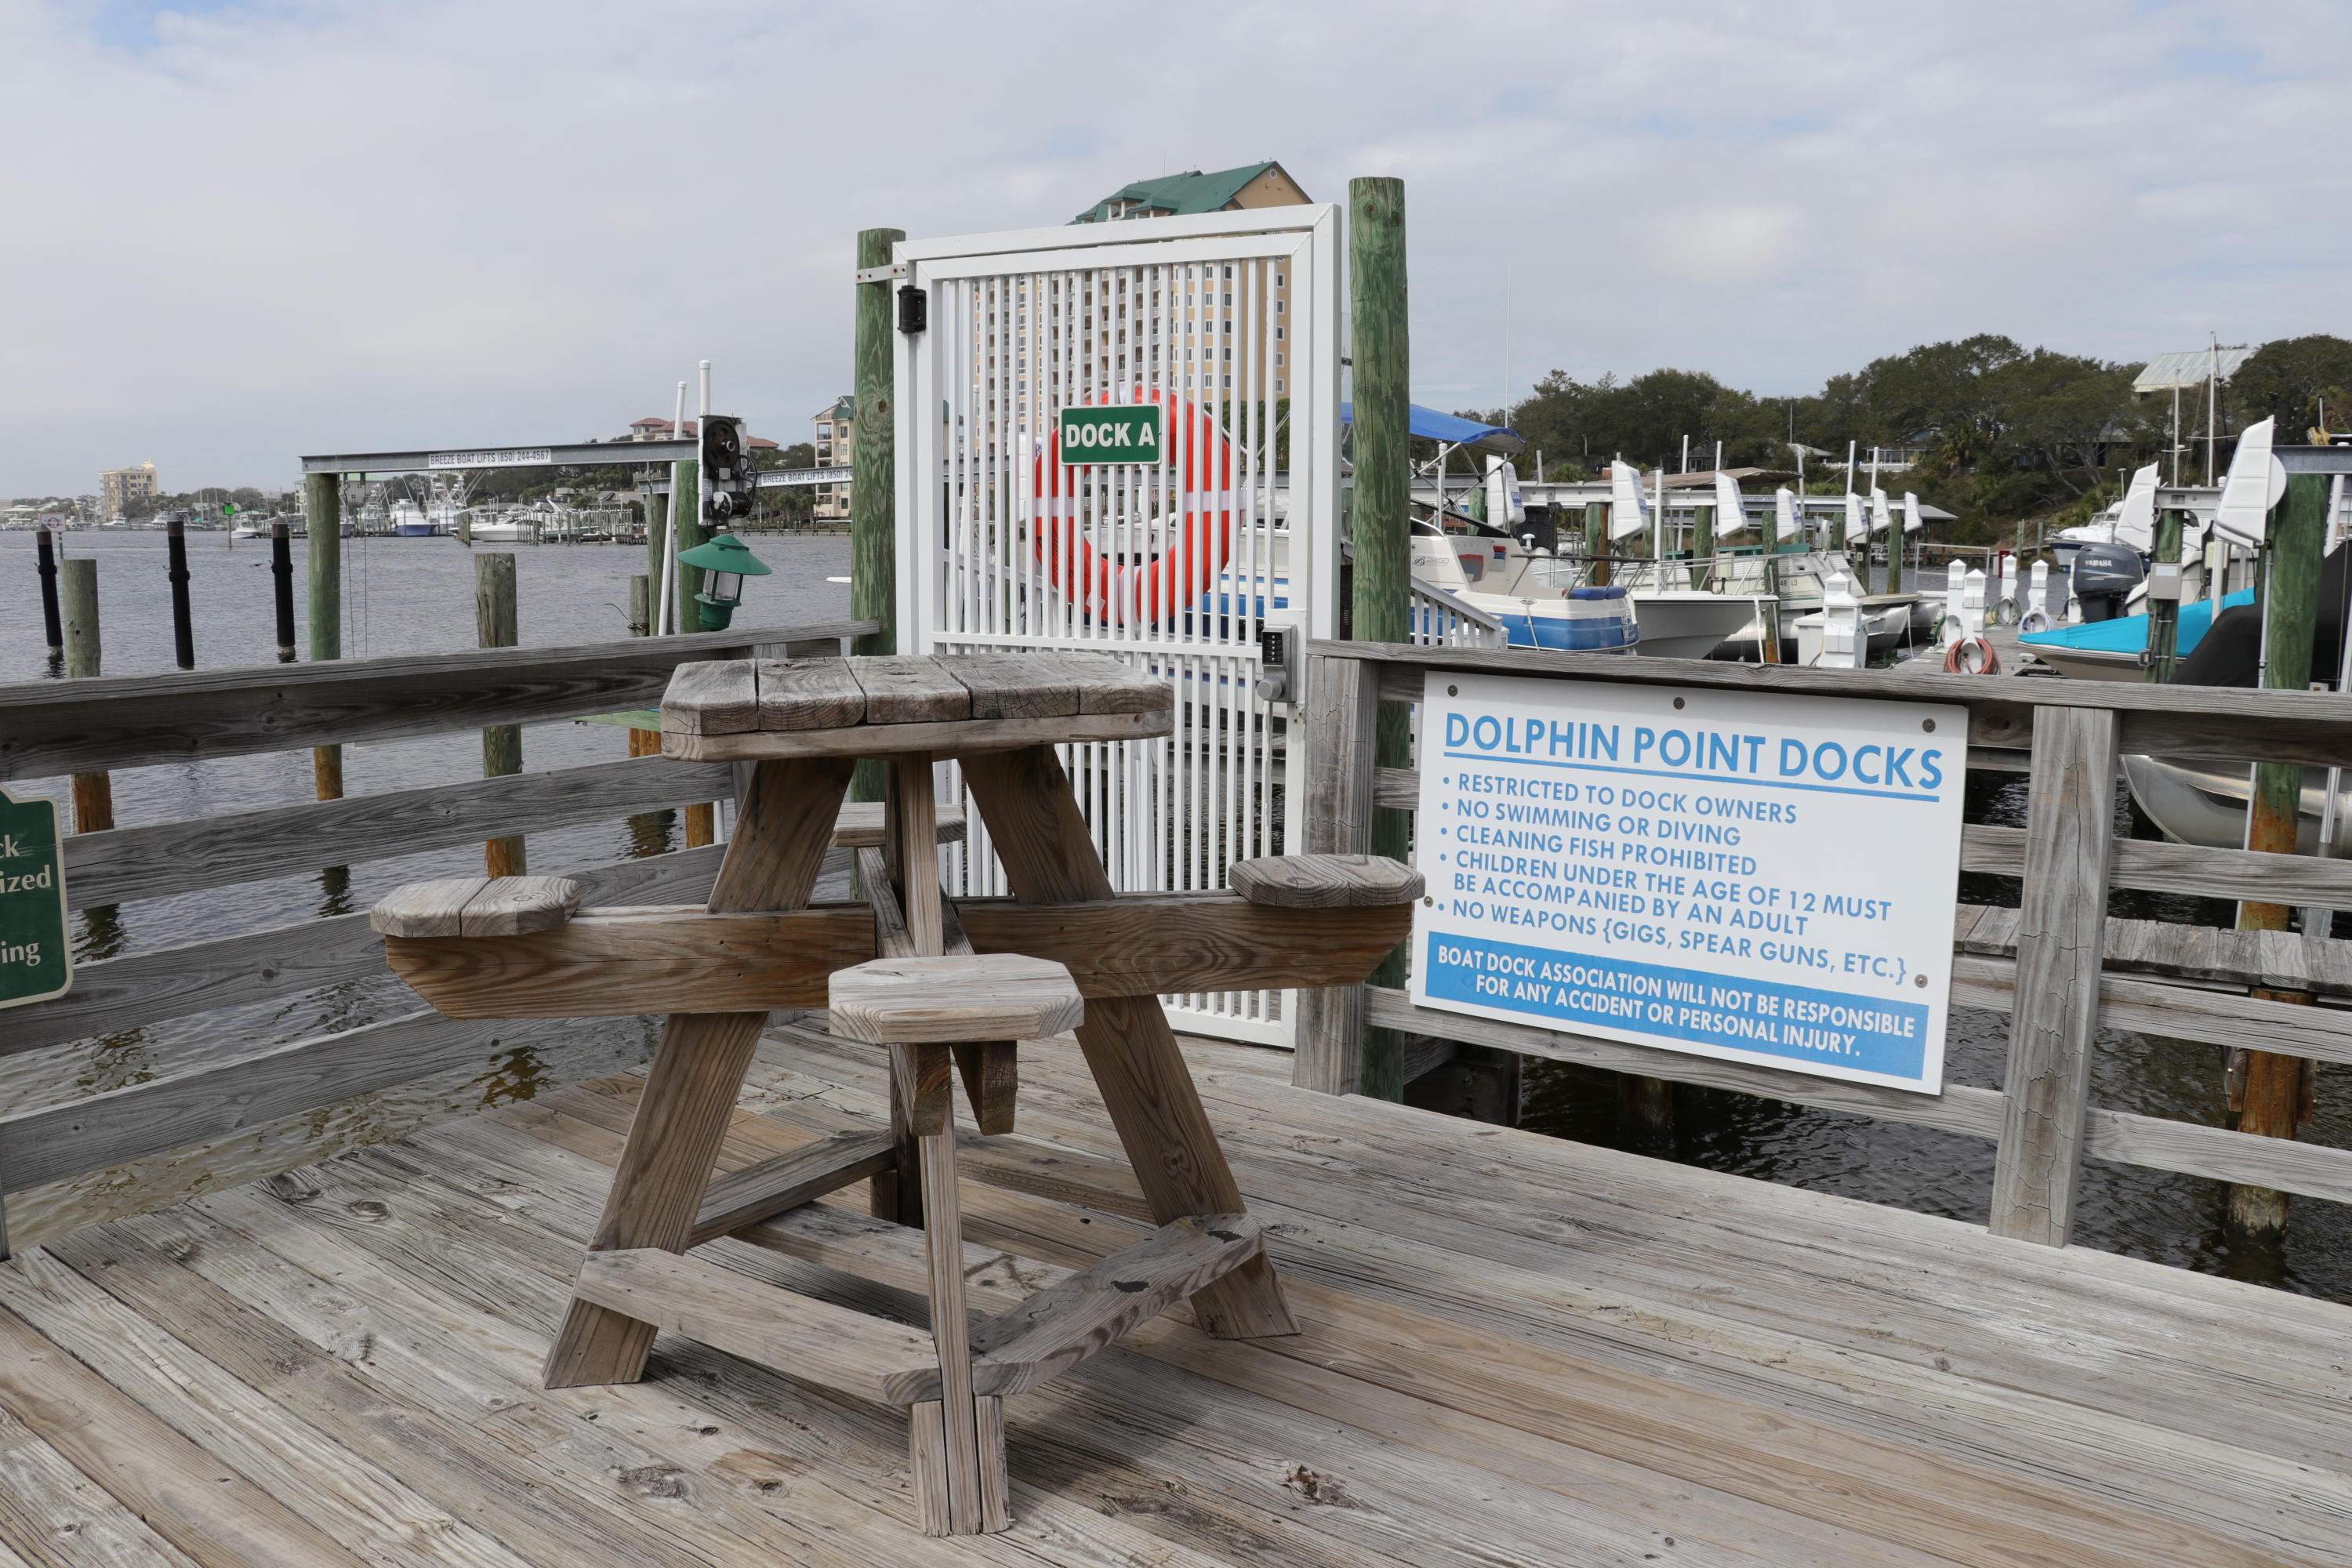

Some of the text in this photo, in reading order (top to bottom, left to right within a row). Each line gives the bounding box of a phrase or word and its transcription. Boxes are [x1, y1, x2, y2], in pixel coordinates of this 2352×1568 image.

[430, 450, 549, 465] BREEZE BOAT LIFTS (850) 244-4567
[1065, 422, 1156, 448] DOCK A
[763, 474, 786, 484] BREEZE
[788, 473, 805, 482] BOAT
[808, 471, 825, 481] LIFTS
[827, 470, 843, 480] (850)
[1445, 713, 1943, 789] DOLPHIN POINT DOCKS
[1457, 799, 1741, 846] NO SWIMMING OR DIVING
[1458, 773, 1798, 824] RESTRICTED TO DOCK OWNERS
[1457, 825, 1757, 876] CLEANING FISH PROHIBITED
[1454, 873, 1809, 935] BE ACCOMPANIED BY AN ADULT
[1457, 850, 1893, 921] CHILDREN UNDER THE AGE OF 12 MUST
[1453, 898, 1907, 985] NO WEAPONS {GIGS, SPEAR GUNS, ETC.}
[1437, 945, 1916, 1039] BOAT DOCK ASSOCIATION WILL NOT BE RESPONSIBLE
[1475, 974, 1861, 1057] FOR ANY ACCIDENT OR PERSONAL INJURY.
